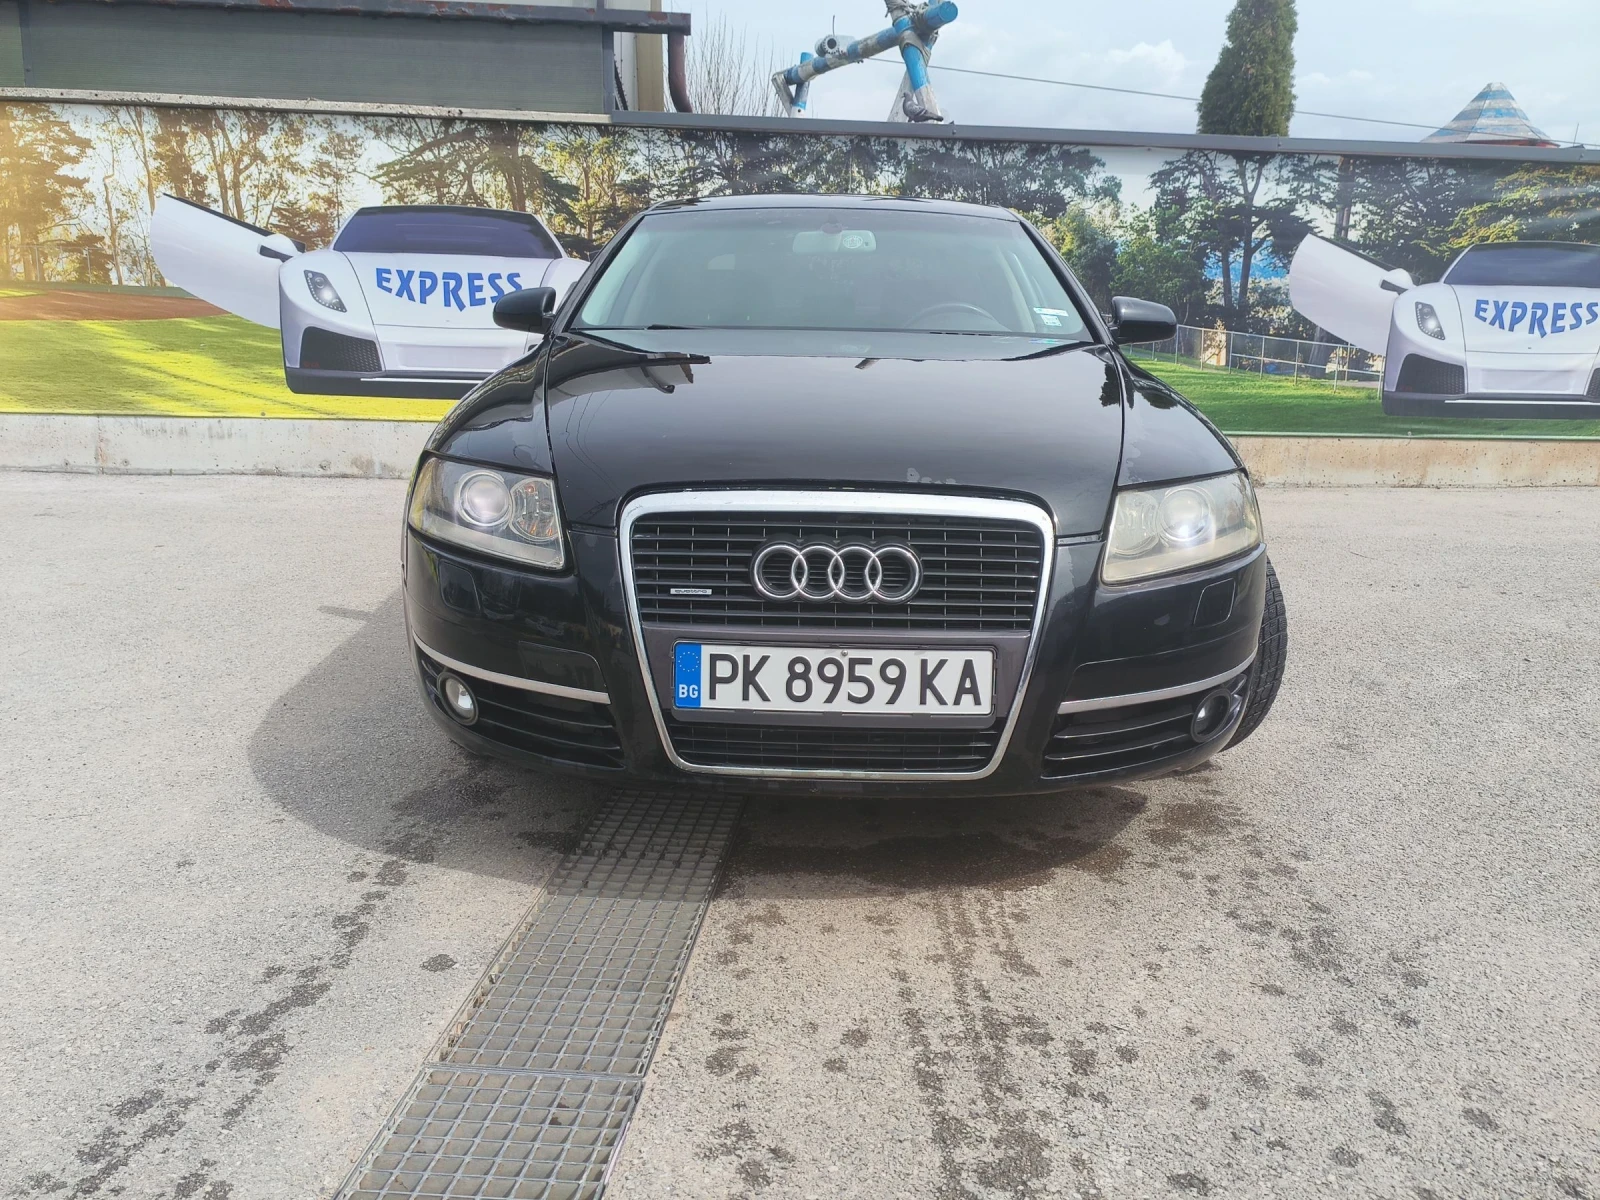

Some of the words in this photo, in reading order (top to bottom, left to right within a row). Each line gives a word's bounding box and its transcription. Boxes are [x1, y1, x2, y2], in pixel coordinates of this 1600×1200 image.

[376, 267, 523, 312] EXPRESS
[1474, 299, 1599, 338] EXPRESS
[679, 684, 698, 698] BG
[709, 653, 771, 701] PK
[785, 656, 907, 704] 8959
[919, 658, 982, 706] KA
